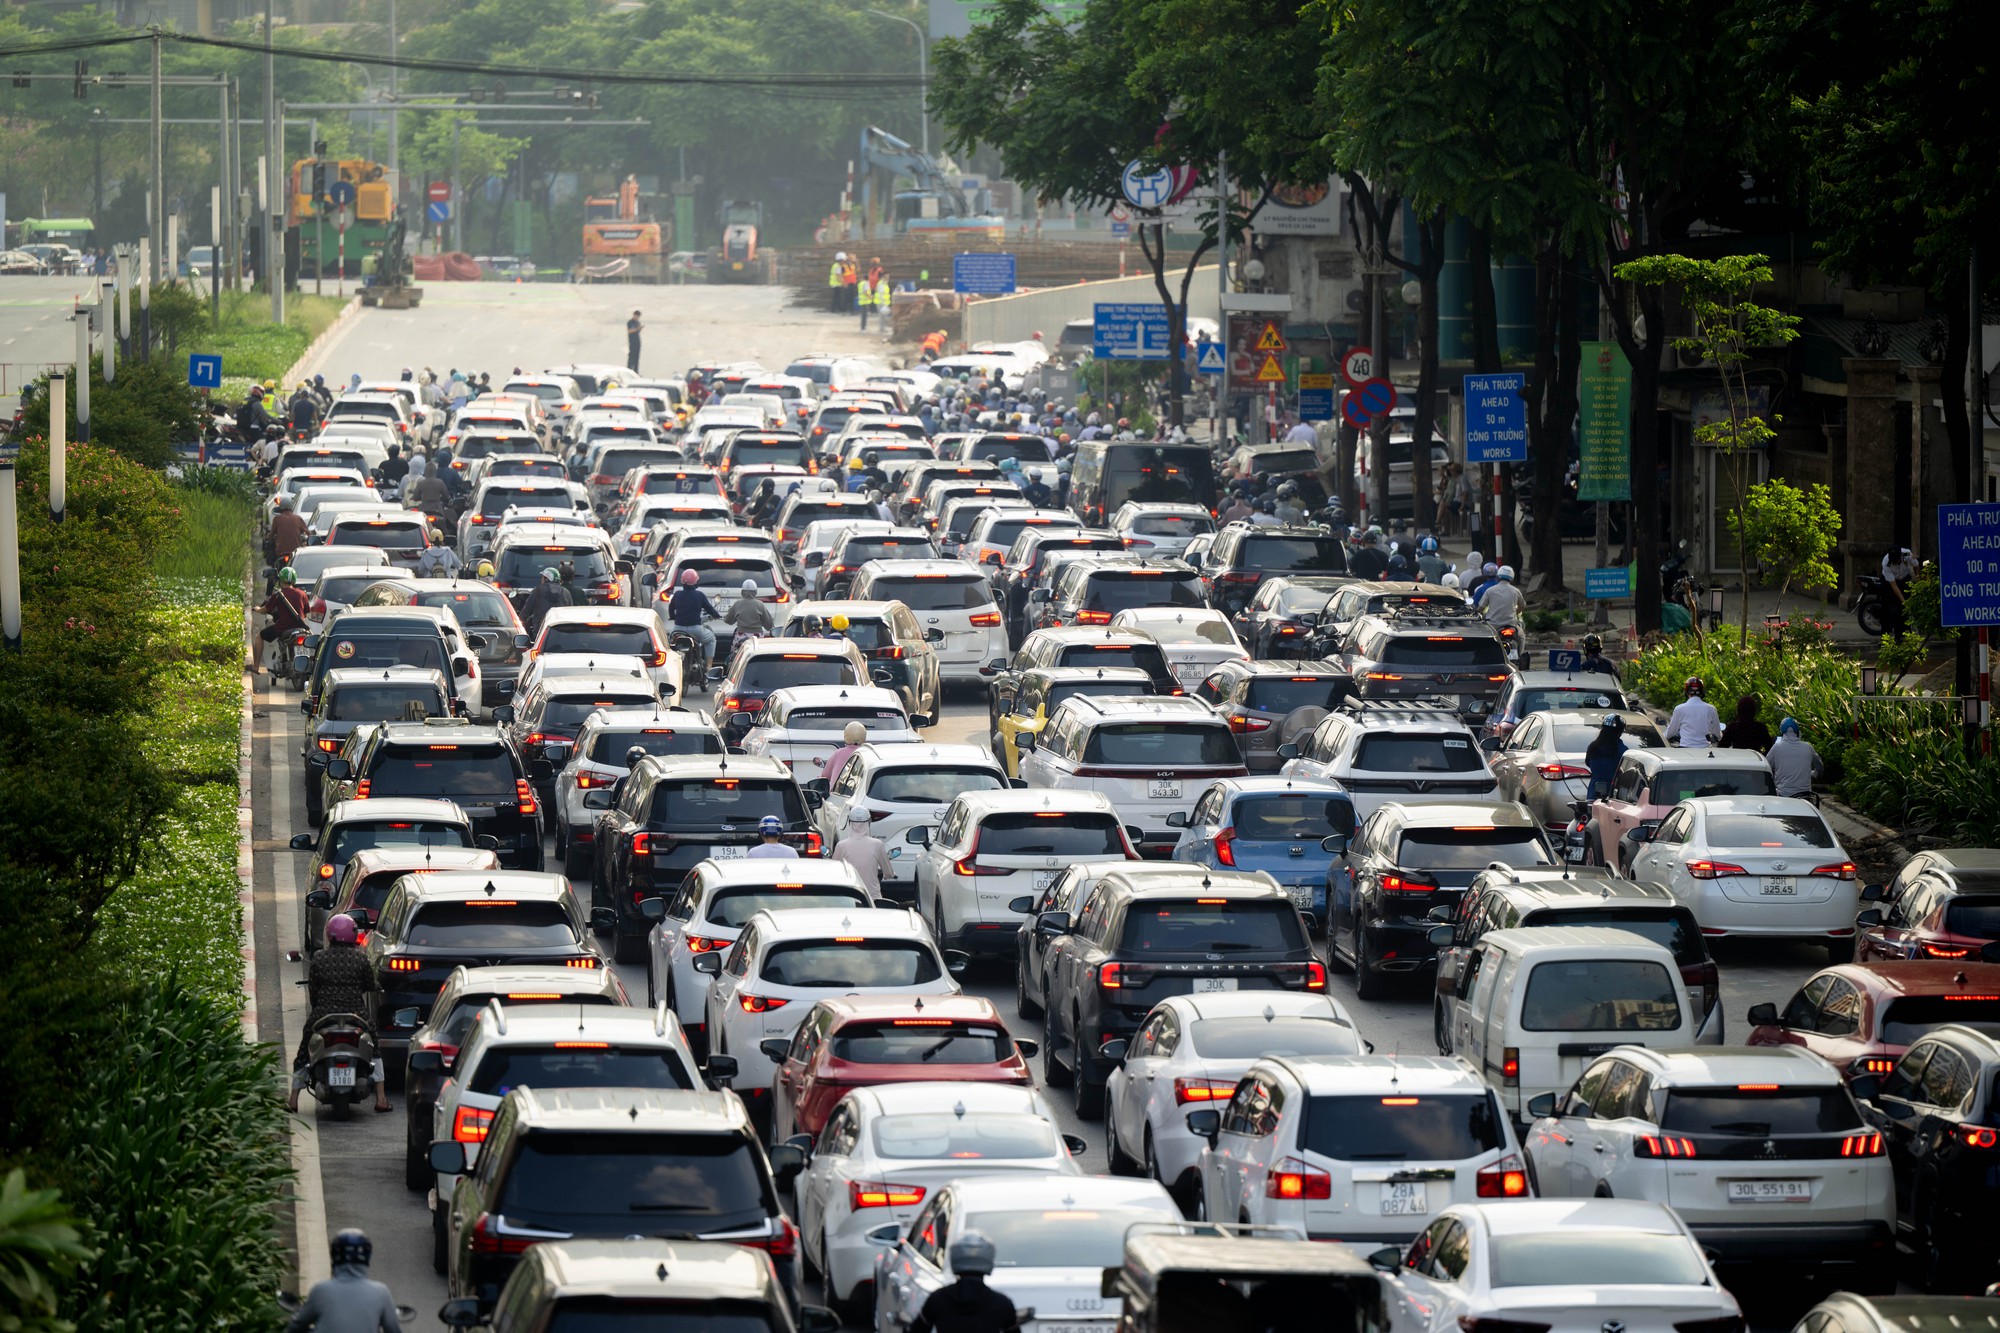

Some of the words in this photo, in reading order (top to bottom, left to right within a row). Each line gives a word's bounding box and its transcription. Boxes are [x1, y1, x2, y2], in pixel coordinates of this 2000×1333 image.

[1353, 358, 1370, 376] 40
[1481, 397, 1509, 407] AHEAD
[1486, 414, 1495, 424] 50
[1498, 416, 1505, 424] m
[1468, 430, 1489, 442] CÔNG
[1483, 448, 1511, 458] WORKS
[1947, 509, 1974, 526] PHÍA
[1977, 510, 2000, 526] TRƯ
[1962, 535, 2000, 550] AHEAD
[1966, 560, 1983, 574] 100
[1988, 562, 1998, 573] m
[1943, 581, 1974, 598] CÔNG
[1556, 652, 1574, 669] G7
[721, 847, 737, 856] 19A
[1770, 877, 1787, 885] 30H
[1763, 885, 1793, 894] 825.45
[1206, 980, 1225, 989] 30K
[332, 1077, 352, 1085] 3180
[1392, 1184, 1415, 1198] 28A
